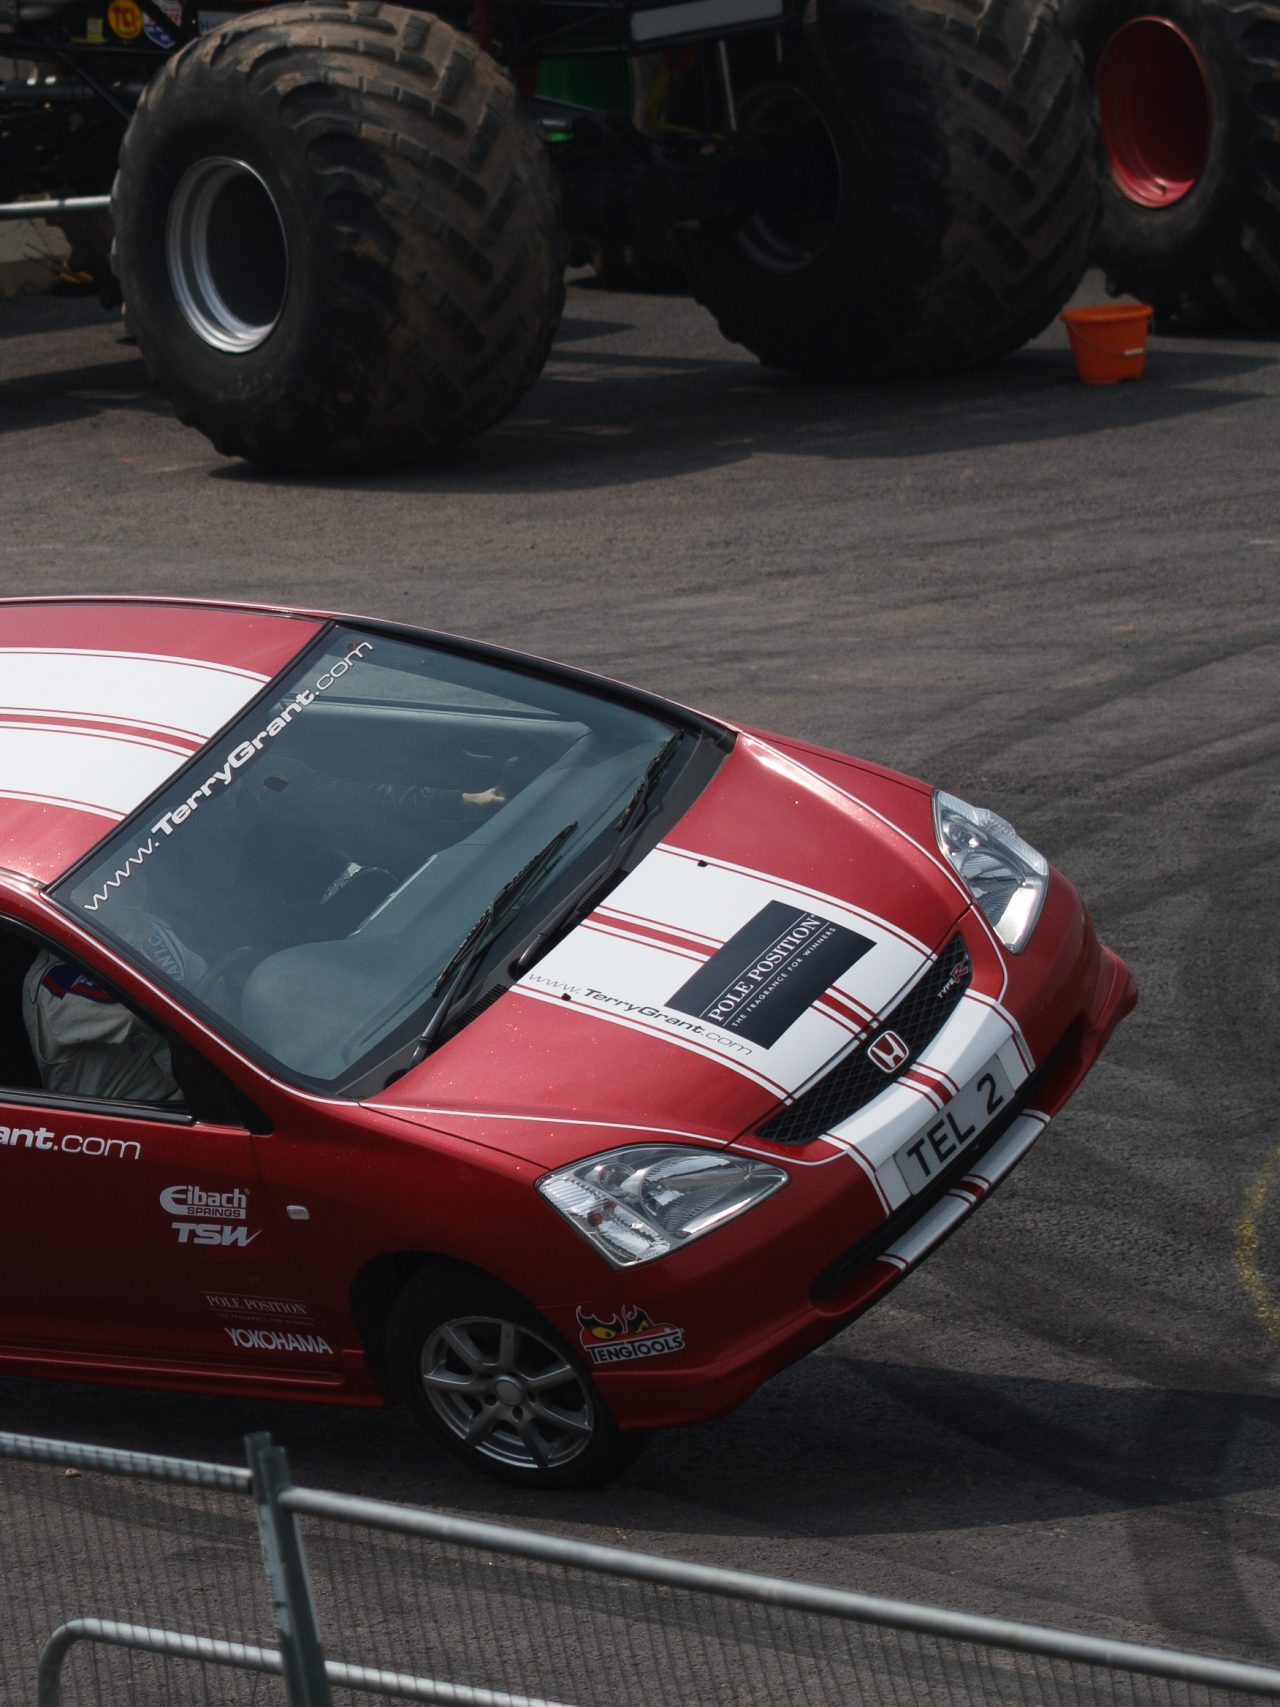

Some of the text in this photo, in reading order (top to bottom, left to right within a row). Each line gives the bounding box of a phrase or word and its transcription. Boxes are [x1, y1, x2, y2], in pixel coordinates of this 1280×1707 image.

[84, 641, 374, 911] www.TerryGrant.com
[707, 917, 821, 1021] POLE POSITION
[731, 927, 836, 1027] THE FRAGRANCE FOR WINNERS
[937, 977, 955, 999] TYPE
[528, 973, 753, 1056] www.TerryGrant.com
[906, 1072, 1004, 1177] TEL 2
[159, 1184, 247, 1218] Eibach
[186, 1206, 241, 1218] SPRINGS
[171, 1221, 263, 1247] TSW
[205, 1294, 307, 1315] POLE POSITION
[223, 1327, 334, 1355] YOKOHAMA
